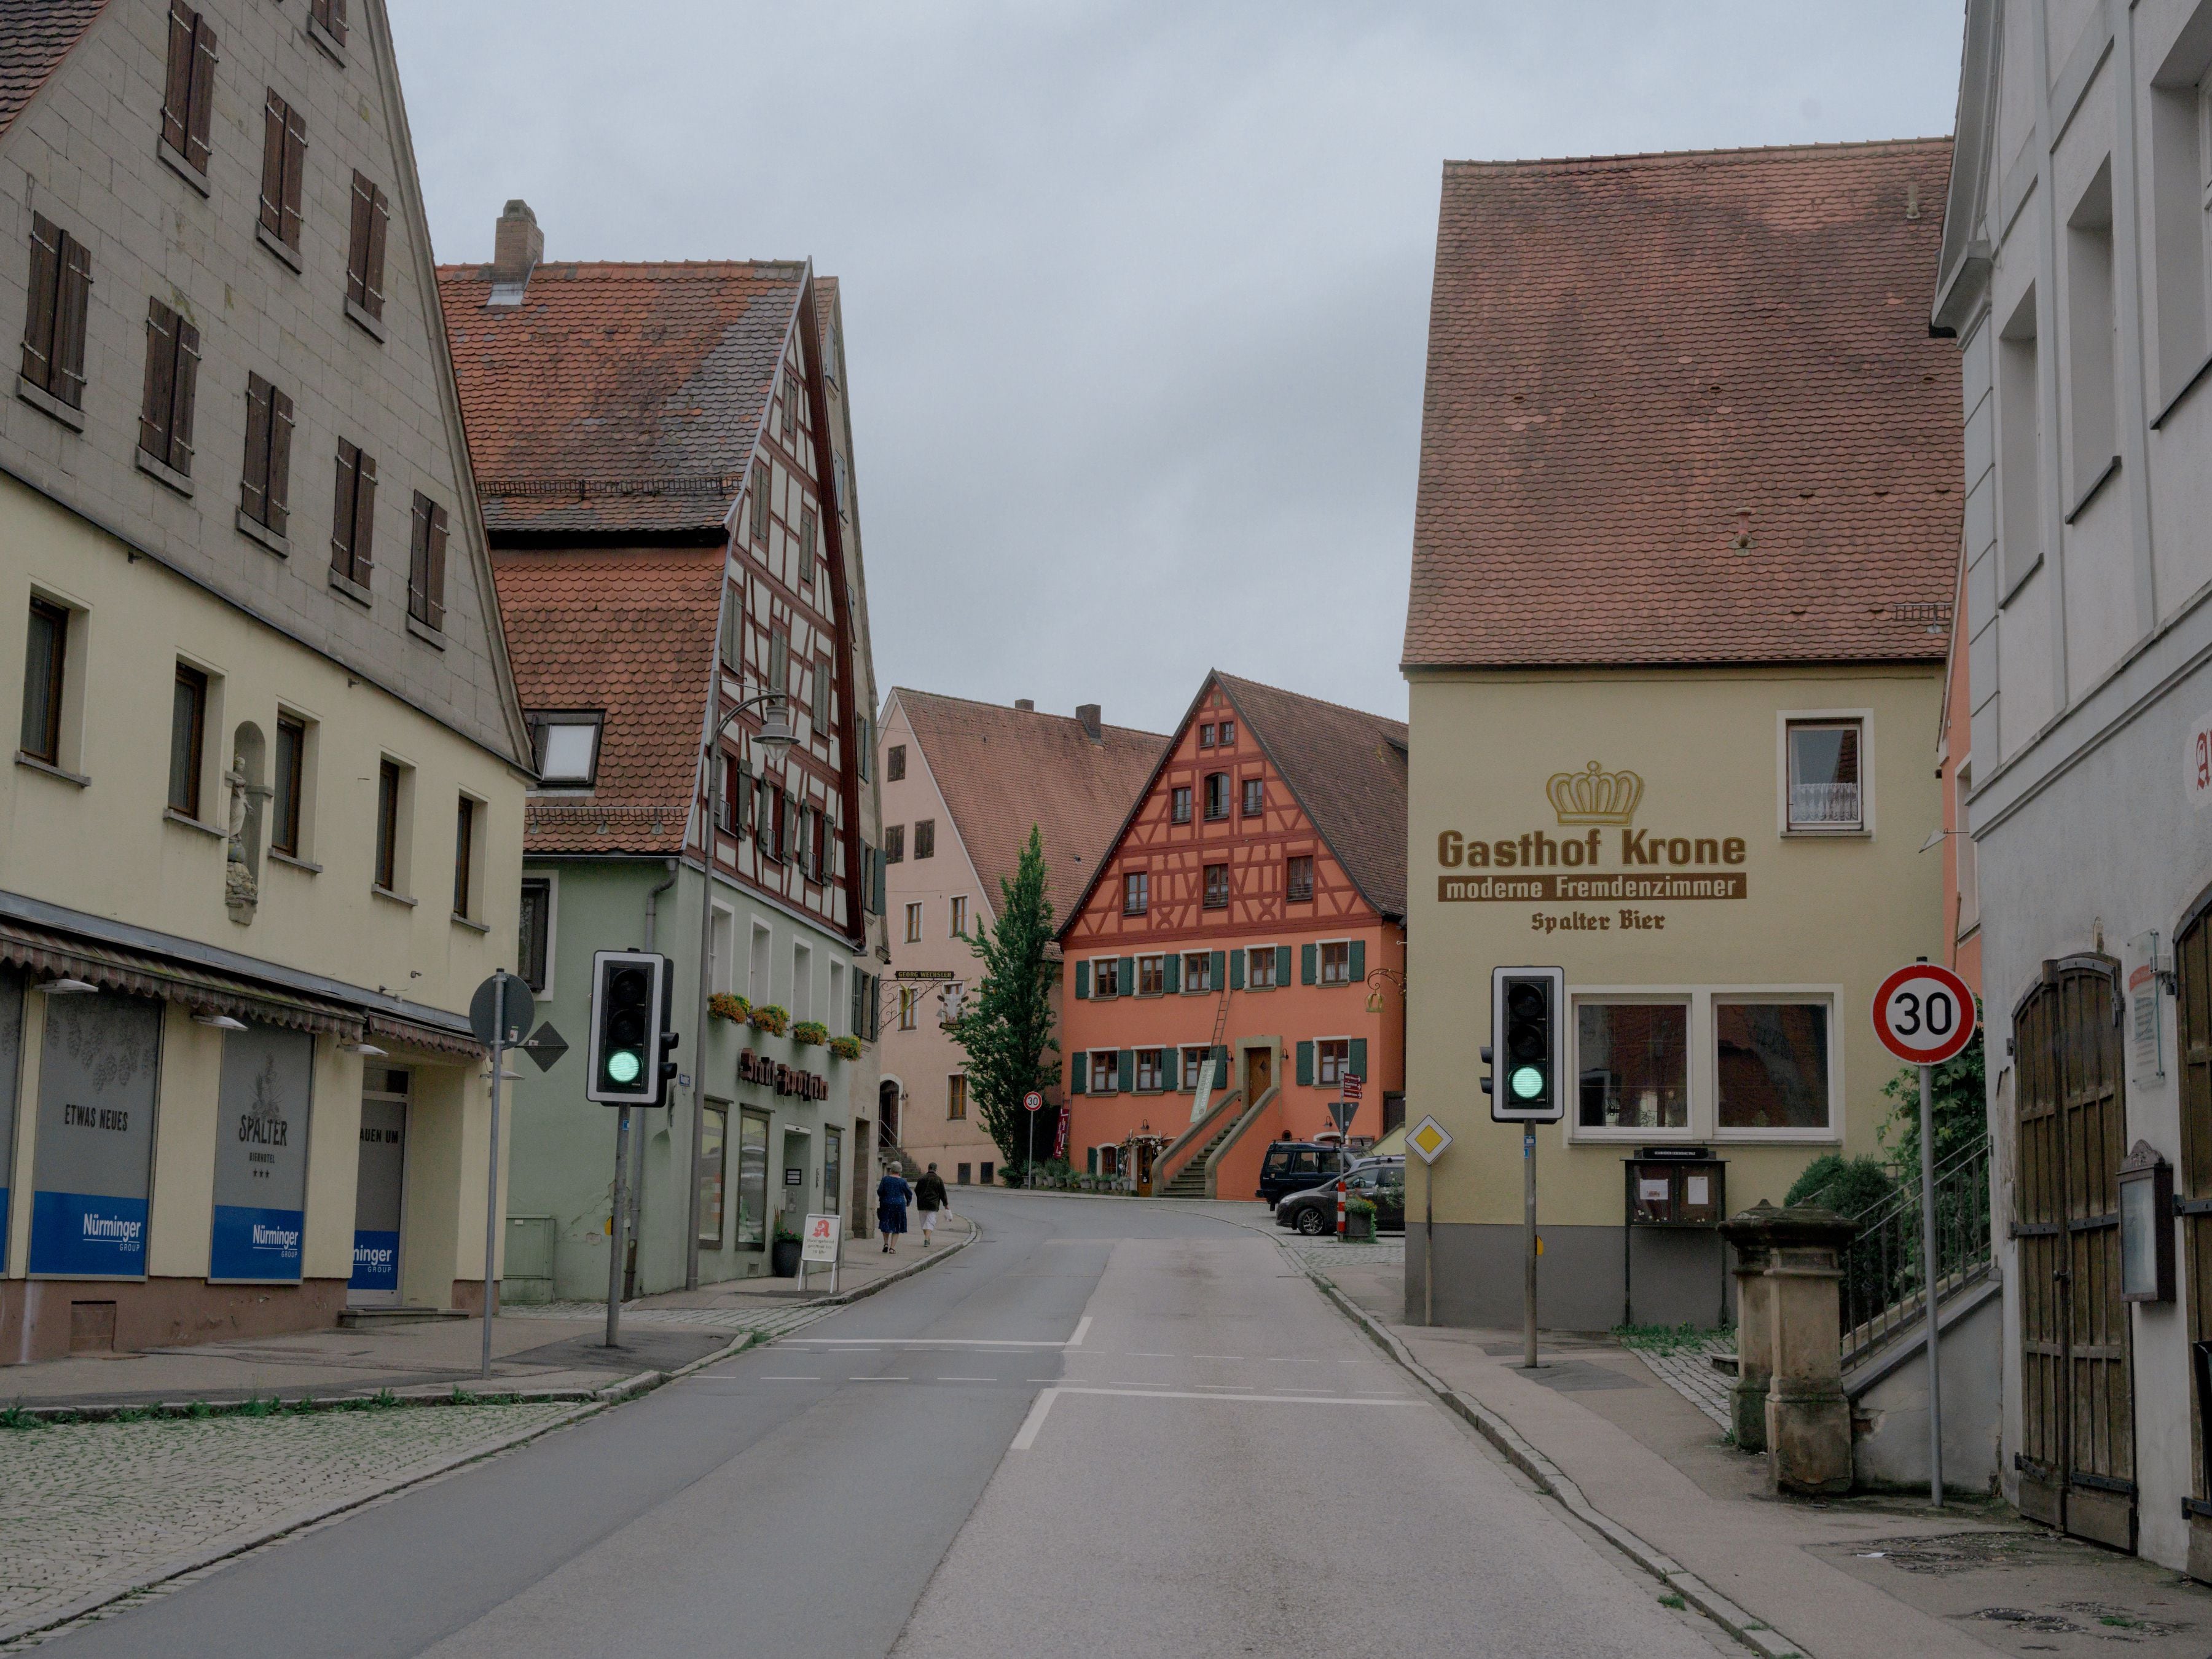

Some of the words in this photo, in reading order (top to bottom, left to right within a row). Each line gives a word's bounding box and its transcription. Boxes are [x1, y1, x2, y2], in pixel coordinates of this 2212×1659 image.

[1438, 828, 1601, 868] Gasthof
[1622, 828, 1747, 866] Krone
[1446, 877, 1542, 898] moderne
[1556, 875, 1736, 898] Fremdenzimmer
[1531, 911, 1610, 935] Spalter
[1619, 909, 1666, 930] Bier
[1894, 992, 1952, 1035] 30
[1201, 1070, 1212, 1107] GENIESSEN
[1027, 1097, 1039, 1107] 30
[65, 1104, 96, 1128] ETWAS
[100, 1109, 128, 1132] NEUES
[239, 1115, 288, 1147] SPALTER
[386, 1130, 399, 1143] UM
[249, 1152, 275, 1164] BIERHOTEL
[84, 1213, 141, 1242] Nürminger
[253, 1224, 299, 1250] Nürminger
[120, 1243, 140, 1252] GROUP
